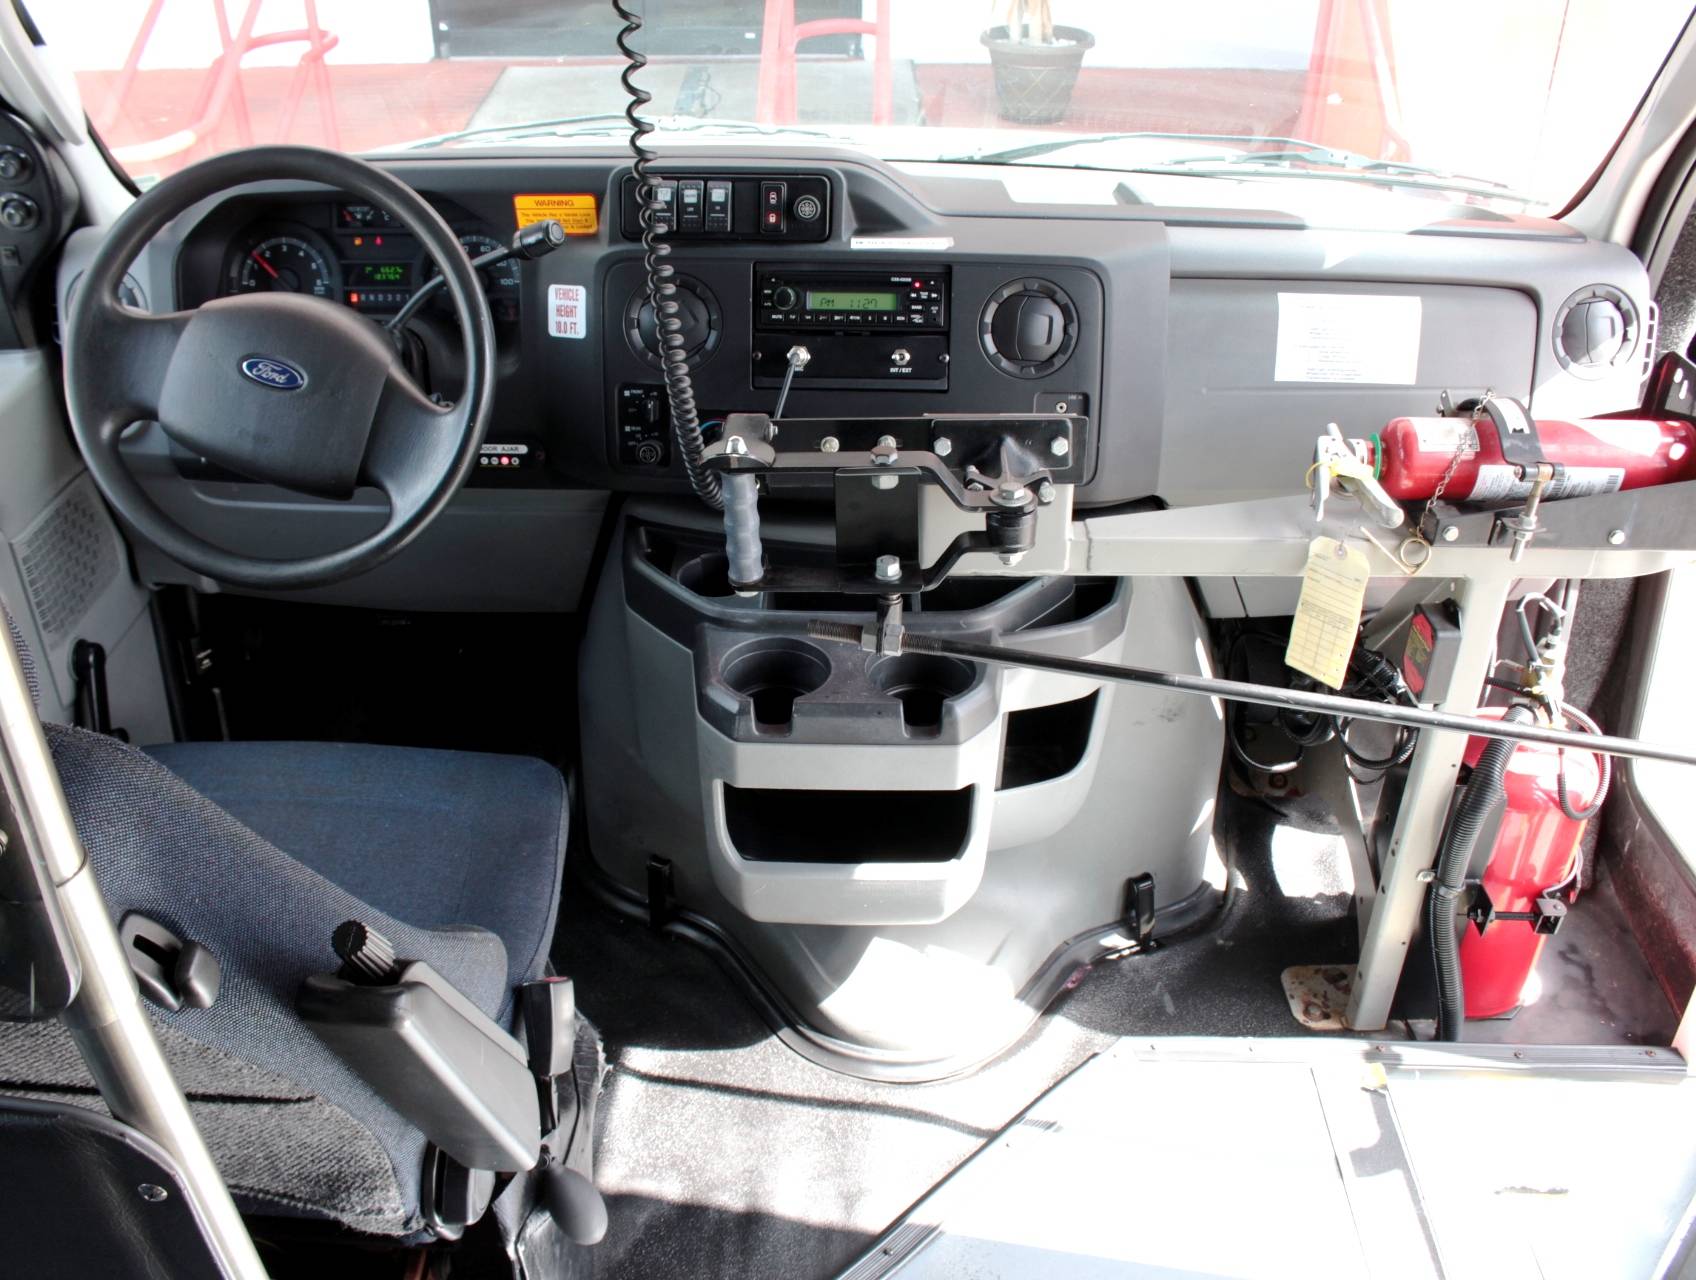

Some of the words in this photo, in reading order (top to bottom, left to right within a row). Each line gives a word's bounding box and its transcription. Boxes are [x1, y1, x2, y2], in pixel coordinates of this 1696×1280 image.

[554, 287, 579, 301] VEHICLE
[555, 304, 577, 318] HEIGHT
[252, 362, 290, 383] Ford
